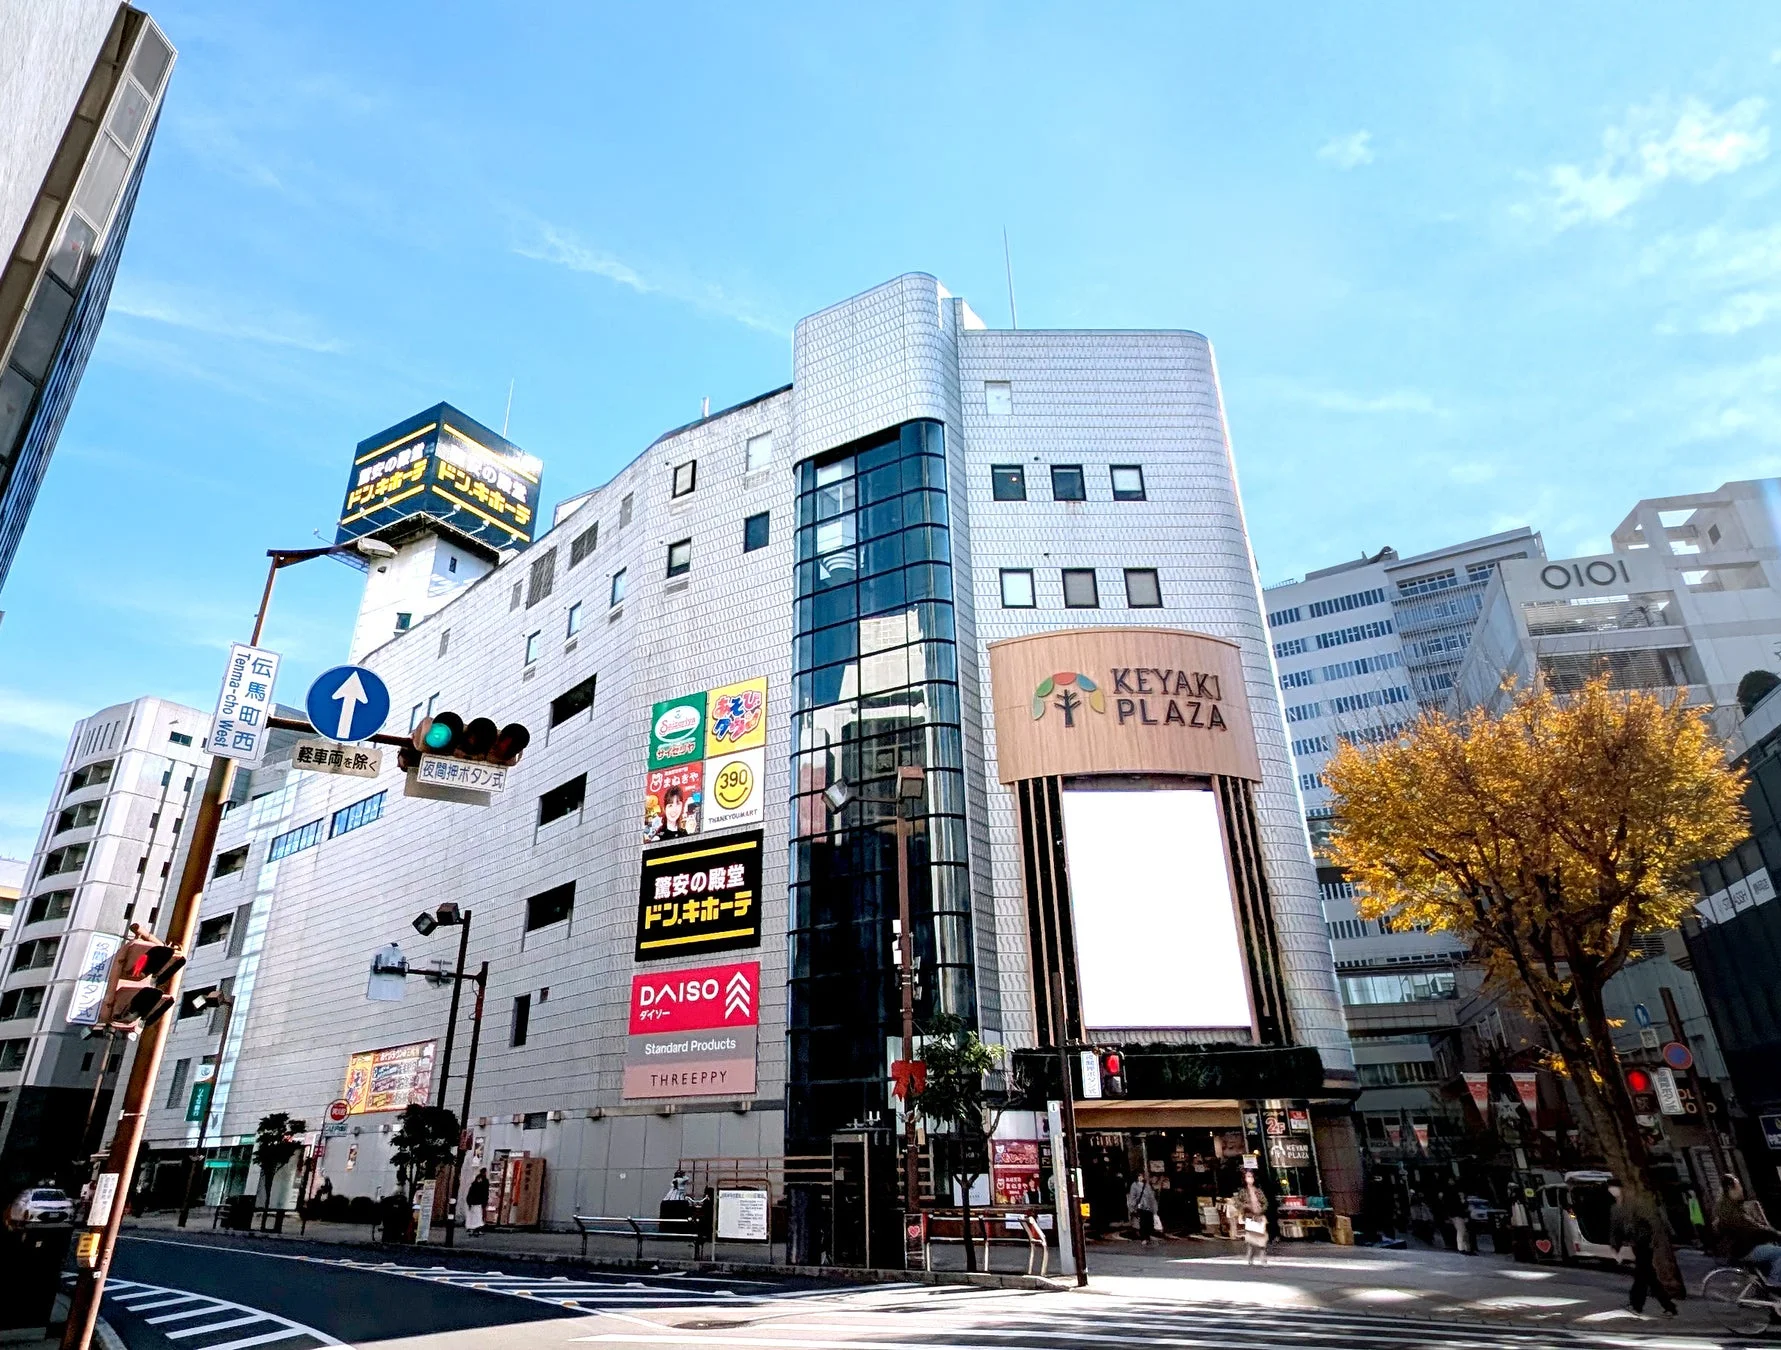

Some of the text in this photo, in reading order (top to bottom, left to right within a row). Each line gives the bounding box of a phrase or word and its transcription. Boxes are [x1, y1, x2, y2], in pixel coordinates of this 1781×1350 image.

[1111, 667, 1222, 701] KEYAKI
[214, 652, 251, 748] Tenma-cho West
[232, 656, 273, 752] 伝馬町西
[1117, 698, 1228, 732] PLAZA
[296, 746, 378, 772] 軽車両を除く
[422, 760, 504, 792] 夜間押ボタン式
[720, 769, 748, 790] 390
[653, 863, 745, 899] 驚安の殿堂
[640, 978, 719, 1007] DAISO
[639, 1008, 671, 1021] ダイソー
[645, 1036, 737, 1056] Standard Products
[651, 1070, 728, 1087] THREEPPY
